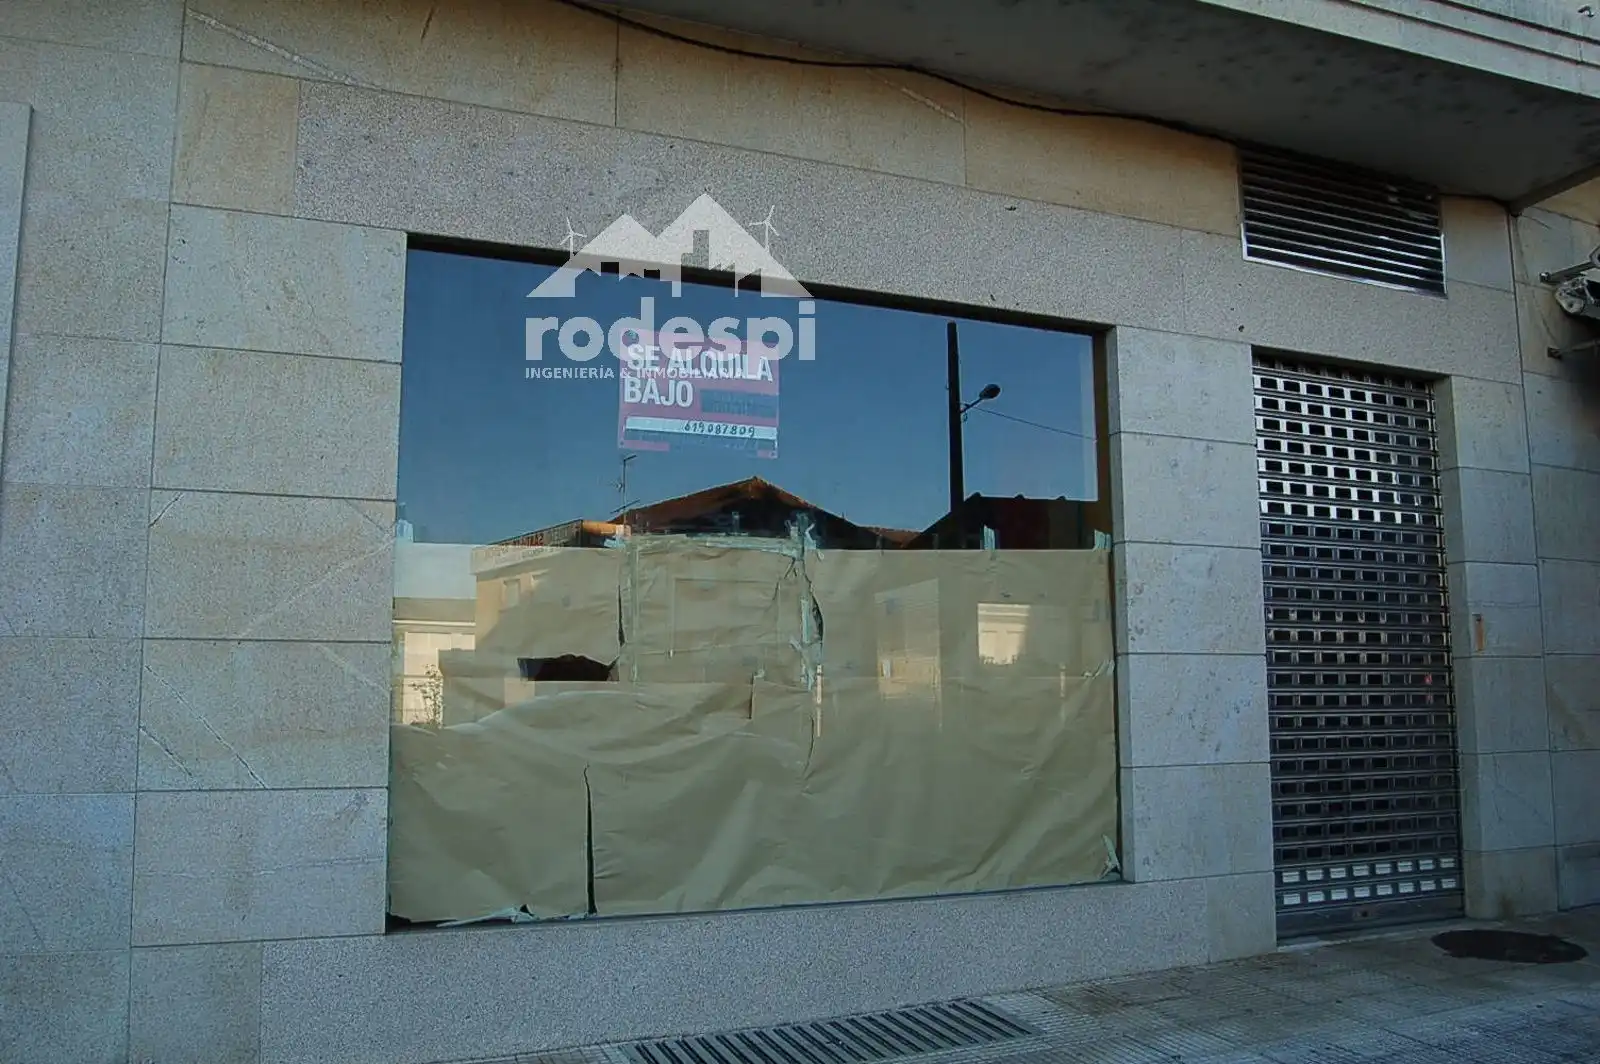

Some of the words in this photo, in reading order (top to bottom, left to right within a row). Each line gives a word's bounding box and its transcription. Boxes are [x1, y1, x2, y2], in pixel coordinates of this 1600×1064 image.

[627, 344, 660, 372] SE
[667, 346, 774, 382] ALQUILA
[624, 376, 694, 408] BAJO
